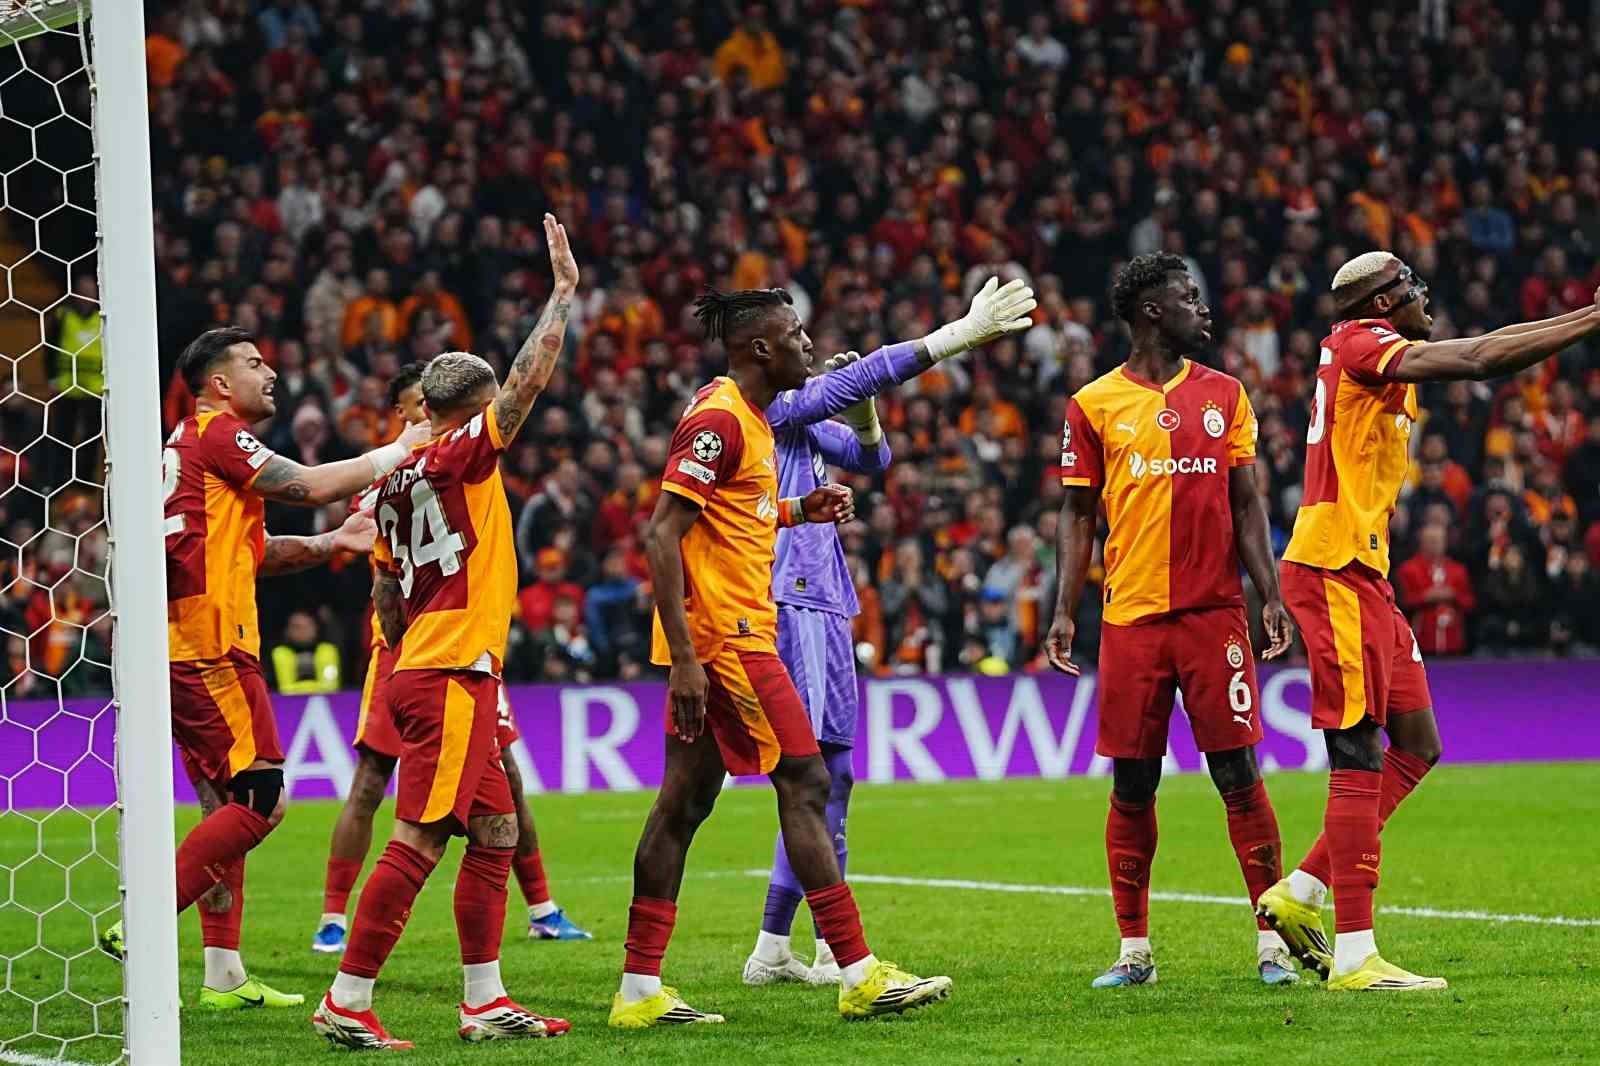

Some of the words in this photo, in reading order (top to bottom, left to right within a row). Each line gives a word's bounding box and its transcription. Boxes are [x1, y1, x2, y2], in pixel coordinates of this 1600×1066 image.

[1150, 457, 1217, 476] SOCAR
[378, 479, 467, 599] 34
[1229, 671, 1252, 712] 6
